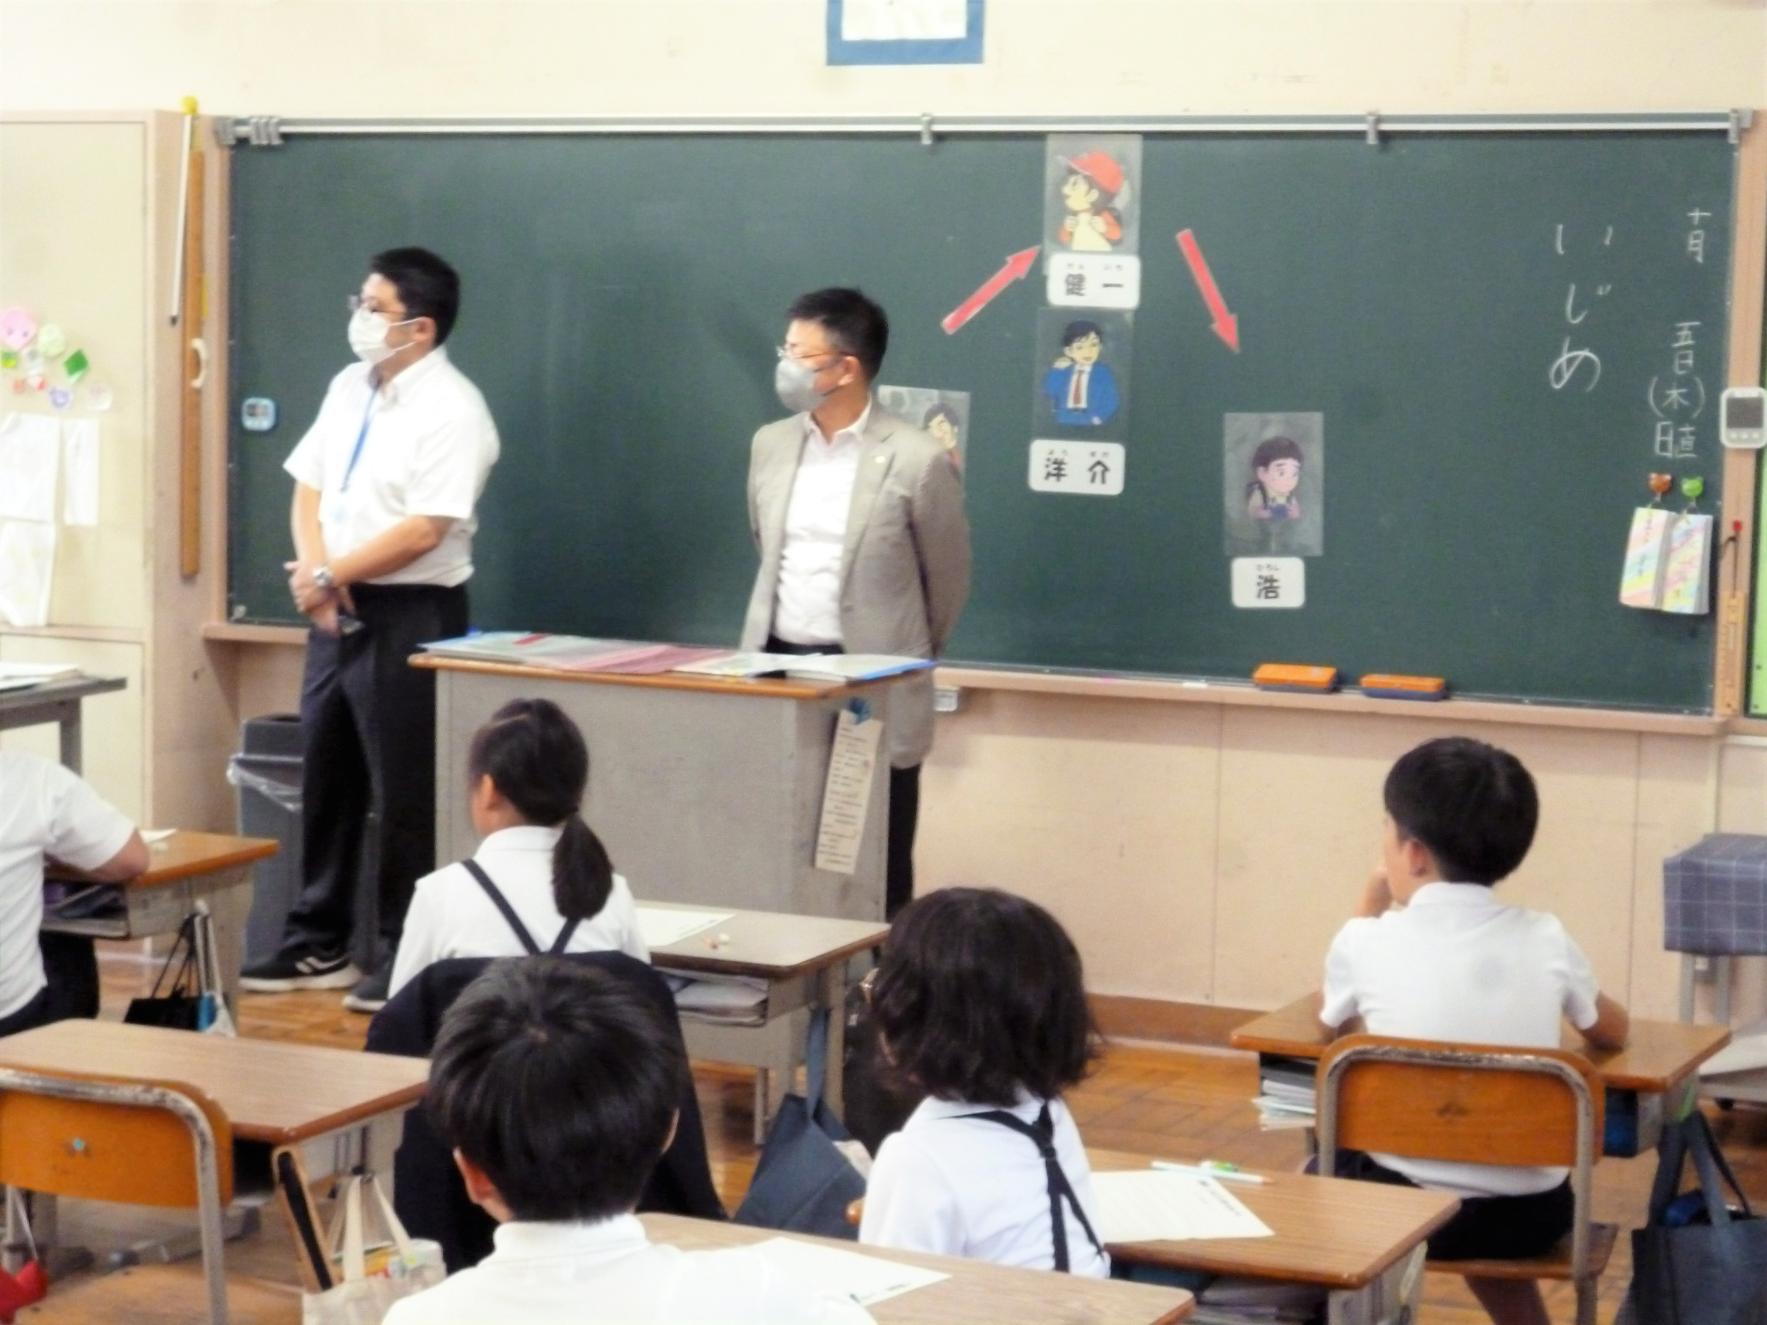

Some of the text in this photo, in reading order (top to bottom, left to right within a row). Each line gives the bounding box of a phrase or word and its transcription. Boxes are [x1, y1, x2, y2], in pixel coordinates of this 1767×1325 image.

[1687, 207, 1712, 263] 十月
[1549, 223, 1612, 393] いじめ
[1655, 421, 1697, 458] 日直
[1044, 457, 1110, 485] 洋介
[1256, 574, 1281, 600] 浩
